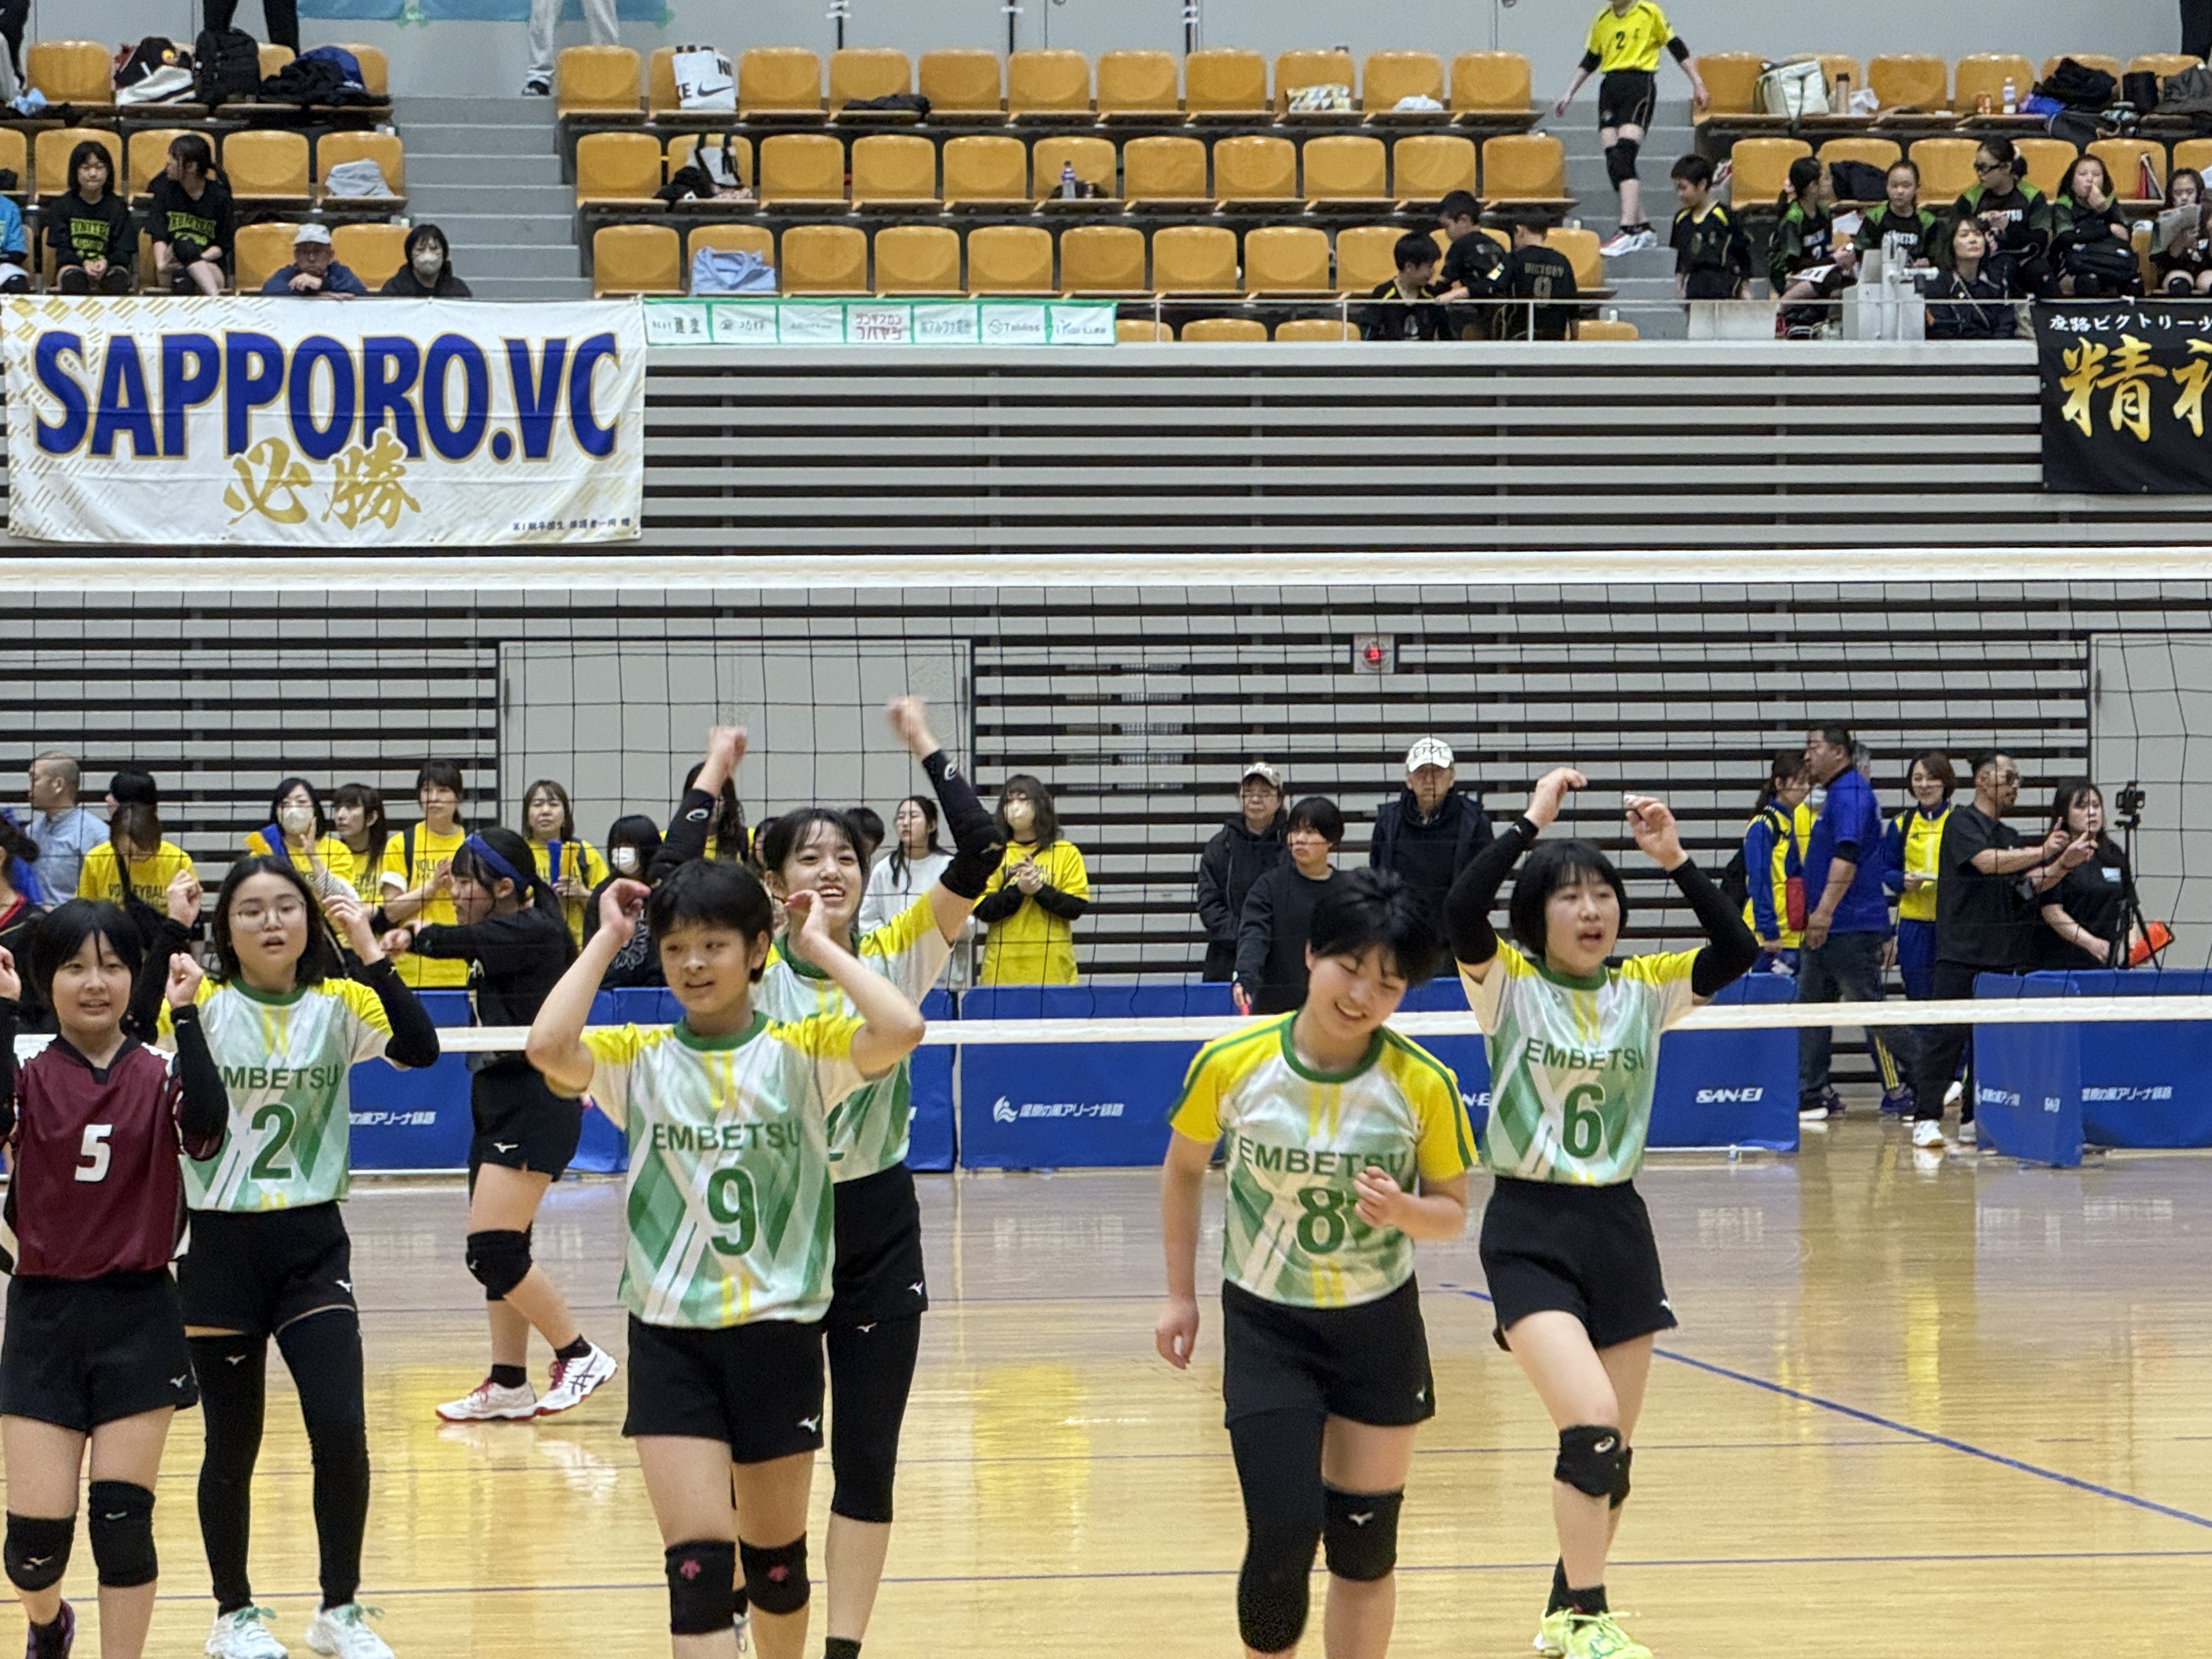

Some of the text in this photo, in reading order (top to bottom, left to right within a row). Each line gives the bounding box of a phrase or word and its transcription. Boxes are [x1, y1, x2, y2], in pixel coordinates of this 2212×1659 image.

[1616, 31, 1626, 50] 2
[31, 328, 621, 464] SAPPORO.VC
[223, 426, 421, 531] 必勝
[219, 1063, 339, 1090] MBETSU
[75, 1124, 113, 1182] 5
[250, 1103, 296, 1180] 2
[652, 1120, 802, 1151] EMBETSU
[1562, 1084, 1605, 1159] 6
[1239, 1135, 1406, 1177] EMBETSU
[707, 1167, 757, 1256] 9
[1296, 1187, 1346, 1254] 8
